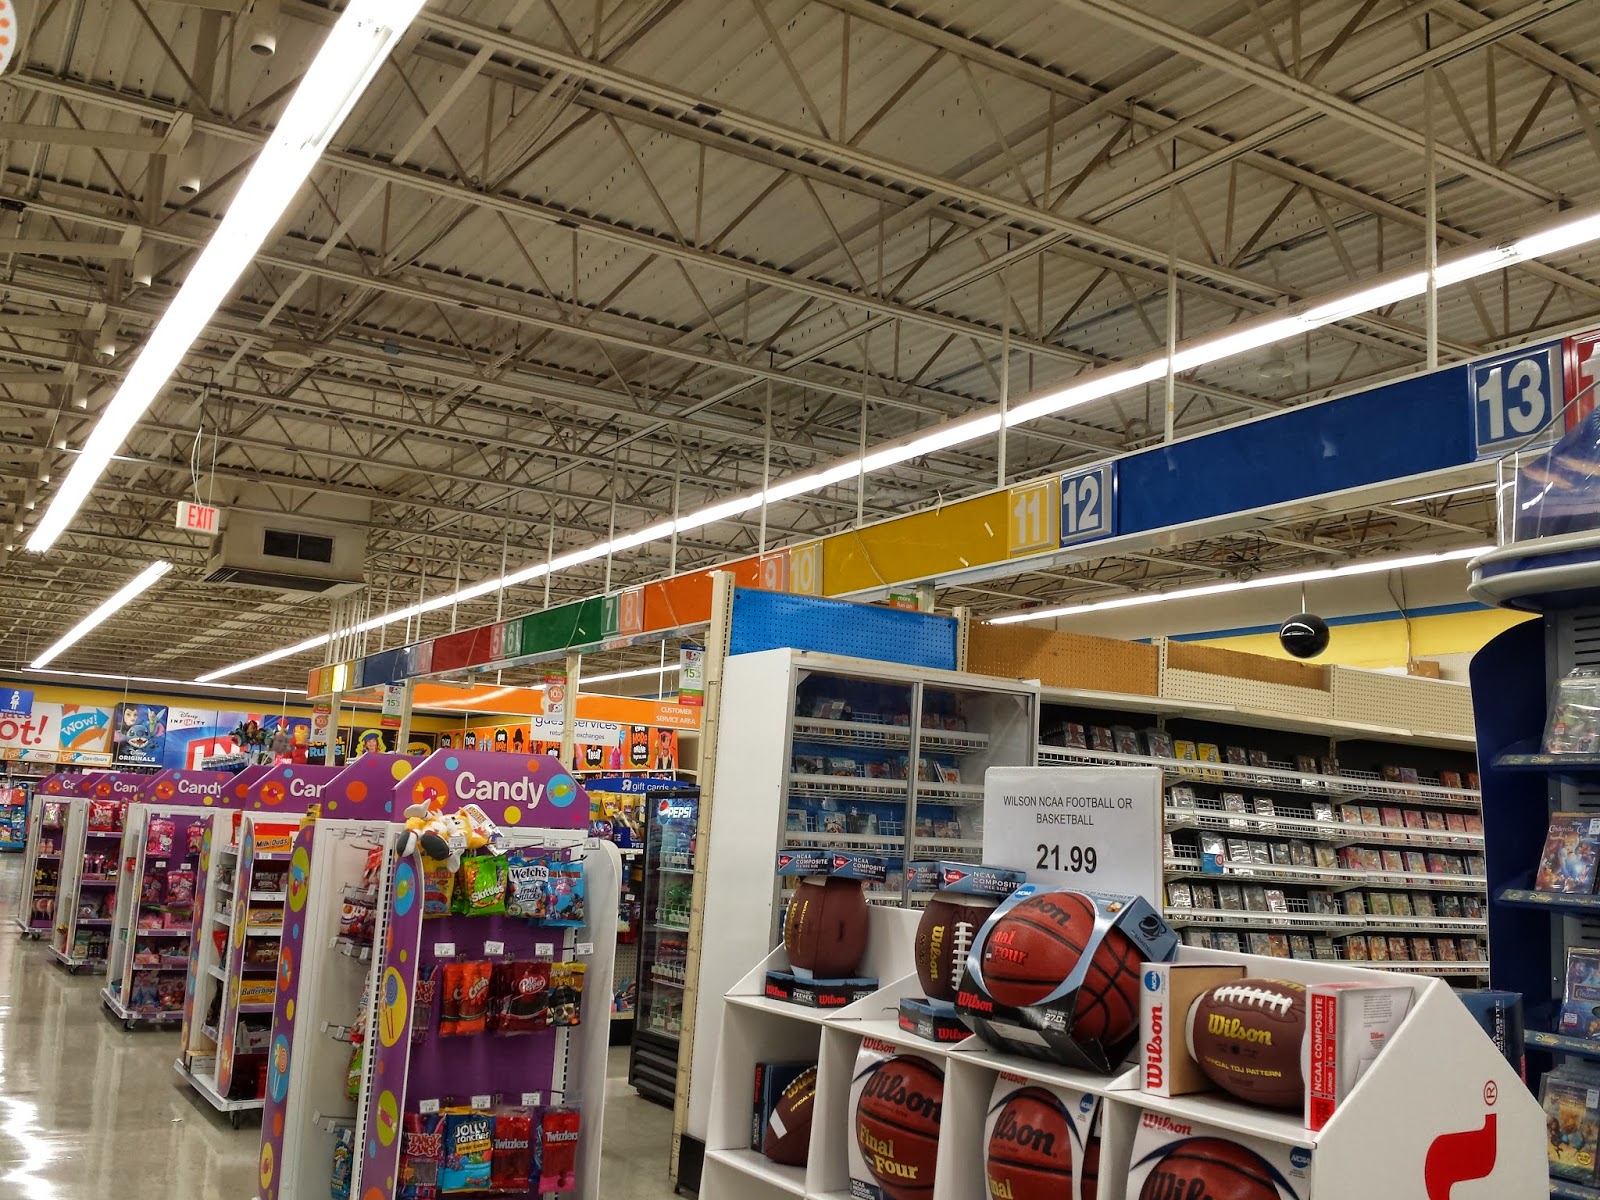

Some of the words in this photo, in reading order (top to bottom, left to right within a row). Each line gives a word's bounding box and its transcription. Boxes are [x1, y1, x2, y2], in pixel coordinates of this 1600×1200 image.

[1479, 359, 1545, 439] 13
[1063, 475, 1099, 533] 12
[187, 505, 215, 530] EXIT
[1014, 491, 1040, 544] 11
[765, 560, 777, 589] 9
[792, 551, 813, 592] 10
[606, 599, 613, 631] 7
[625, 595, 633, 627] 8
[493, 627, 499, 654] 5
[507, 625, 514, 652] 6
[179, 711, 198, 719] Disney
[661, 707, 692, 715] CUSTOMER
[61, 714, 97, 736] WOW!
[170, 718, 205, 726] INFINITY
[455, 772, 545, 809] Candy
[632, 780, 645, 791] gift
[647, 782, 669, 791] cards
[1003, 796, 1037, 807] WILSON
[1039, 796, 1063, 807] NCAA
[1066, 797, 1115, 809] FOOTBALL
[1117, 798, 1133, 809] OR
[667, 806, 692, 818] PEPSI
[1036, 813, 1094, 825] BASKETBALL
[272, 838, 287, 846] Duds
[1036, 843, 1097, 874] 21.99
[511, 867, 547, 879] Welch's
[853, 863, 885, 872] COMPOSITE
[973, 871, 996, 880] NCAA
[973, 878, 1022, 889] COMPOSITE
[471, 885, 505, 902] Skittles
[930, 925, 945, 980] Wilson
[992, 945, 1028, 967] Four
[468, 977, 489, 999] Crush
[522, 979, 544, 993] Pepper
[766, 985, 788, 999] Wilson
[819, 995, 846, 1005] Wilson
[958, 991, 993, 1012] Wilson
[1208, 1013, 1273, 1046] Wilson
[1315, 998, 1323, 1059] COMPOSITE
[863, 1037, 896, 1054] Wilson
[1146, 1005, 1162, 1089] Wilson
[1246, 1068, 1282, 1077] PATTERN
[1315, 1062, 1323, 1092] NCAA
[455, 1121, 488, 1138] JOLLY
[1143, 1112, 1192, 1136] Wilson
[409, 1133, 441, 1145] TANGY
[457, 1131, 489, 1143] rancher
[494, 1139, 528, 1149] Twizzlers
[546, 1130, 578, 1142] Twizzlers
[860, 1123, 895, 1159] Final
[408, 1144, 439, 1157] ZANGY
[1290, 1154, 1311, 1164] NCAA
[874, 1155, 919, 1180] Four
